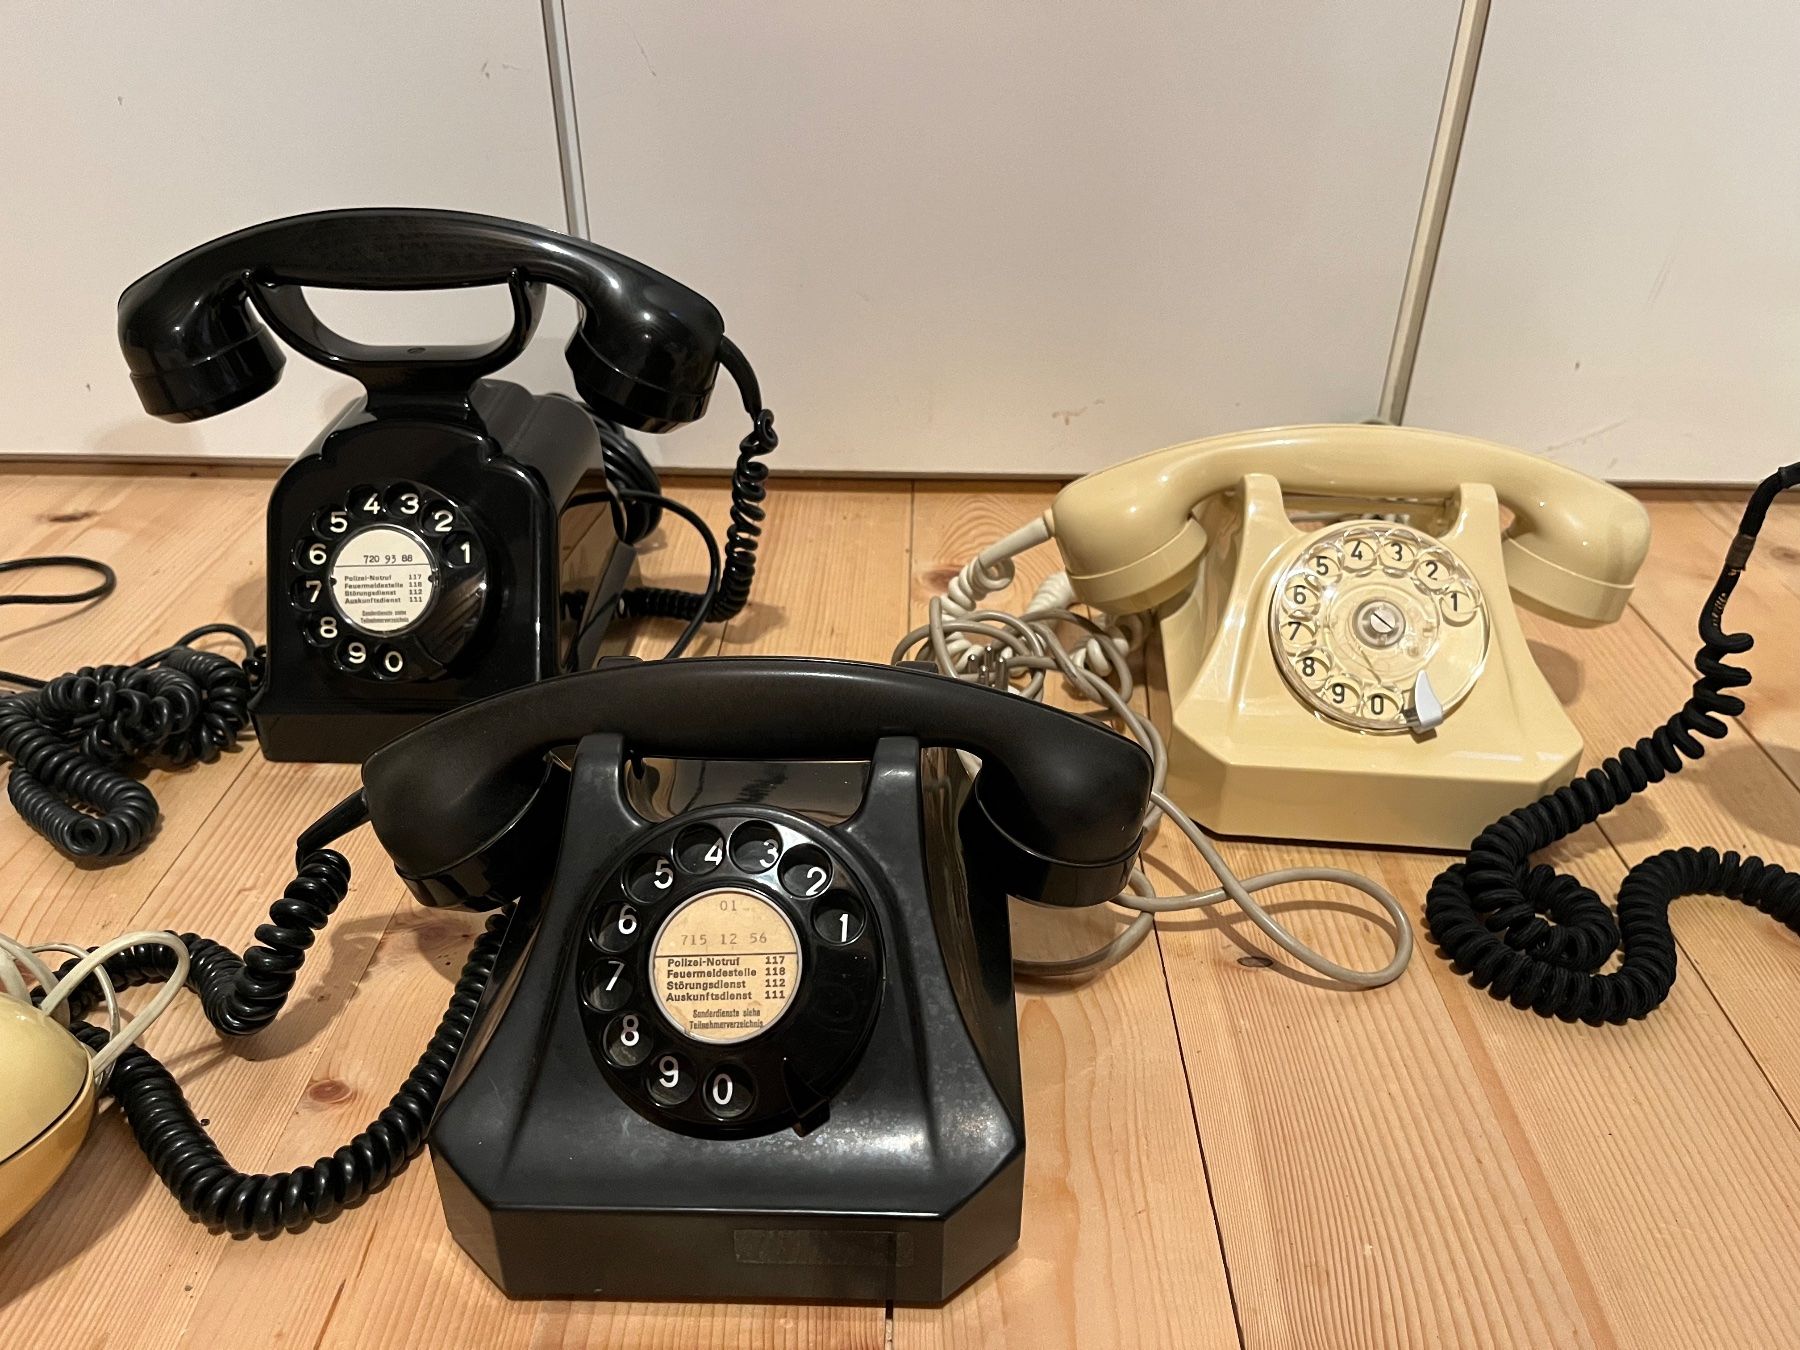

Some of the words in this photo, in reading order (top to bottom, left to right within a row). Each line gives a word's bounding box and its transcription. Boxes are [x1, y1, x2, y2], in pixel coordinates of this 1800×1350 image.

[364, 493, 380, 514] 4
[401, 493, 419, 514] 3
[330, 511, 347, 533] 5
[434, 510, 453, 532] 2
[309, 543, 327, 565] 6
[363, 555, 380, 563] 720
[402, 554, 413, 563] 88
[461, 541, 471, 564] 1
[1351, 541, 1363, 560] 4
[1390, 542, 1403, 561] 3
[1316, 556, 1329, 576] 5
[1426, 561, 1438, 581] 2
[305, 580, 322, 603] 7
[1293, 585, 1306, 605] 6
[1450, 592, 1458, 612] 1
[320, 617, 338, 639] 8
[1287, 621, 1301, 640] 7
[348, 642, 366, 664] 9
[385, 651, 403, 673] 0
[1302, 657, 1316, 677] 8
[1332, 683, 1345, 703] 9
[1370, 694, 1384, 715] 0
[704, 837, 724, 866] 4
[759, 839, 779, 868] 3
[653, 859, 674, 889] 5
[805, 866, 827, 896] 2
[720, 900, 737, 912] 01
[618, 904, 637, 935] 6
[839, 913, 849, 942] 1
[681, 934, 707, 946] 715
[720, 933, 737, 945] 12
[750, 932, 767, 944] 56
[667, 957, 740, 968] Polizei-Notruf
[765, 956, 785, 965] 117
[605, 961, 625, 991] 7
[667, 968, 757, 979] Feuermeldestelle
[765, 967, 786, 976] 118
[666, 979, 746, 991] Störungsdienst
[765, 979, 786, 988] 112
[666, 991, 753, 1002] Auskunftsdienst
[764, 990, 785, 1000] 111
[621, 1015, 640, 1047] 8
[659, 1055, 680, 1088] 9
[712, 1074, 733, 1105] 0
